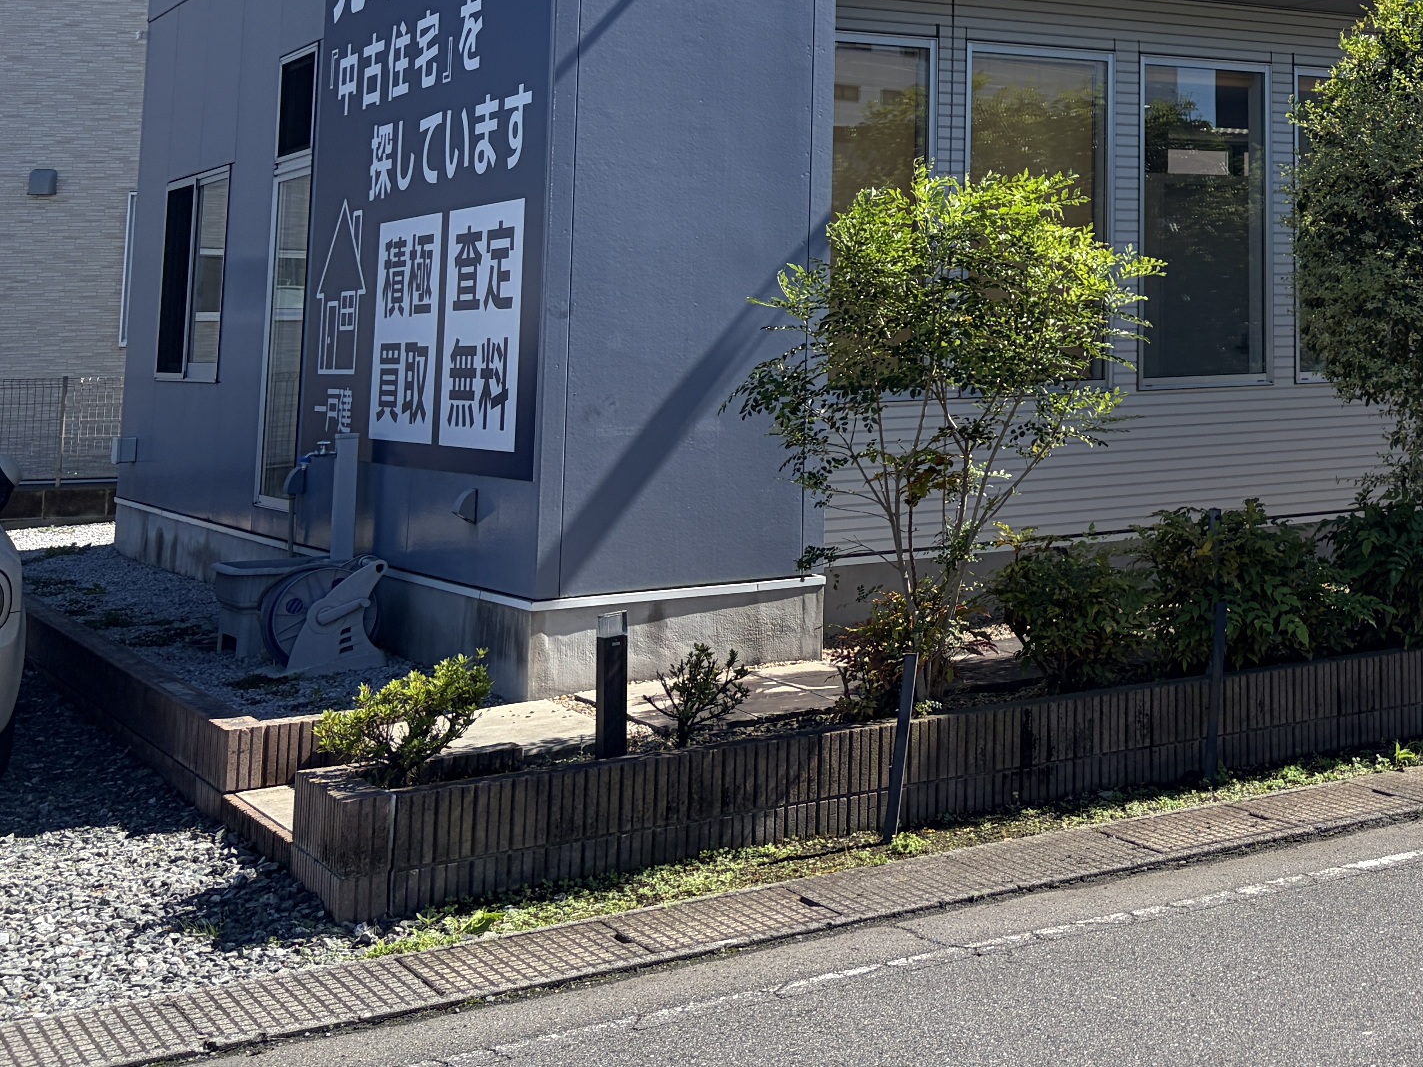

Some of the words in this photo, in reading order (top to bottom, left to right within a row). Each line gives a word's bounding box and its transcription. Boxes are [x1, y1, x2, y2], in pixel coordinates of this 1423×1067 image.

[368, 83, 533, 201] 探しています
[382, 233, 435, 319] 積極
[452, 220, 516, 313] 査定
[314, 386, 353, 433] 一戸建
[376, 342, 429, 425] 買取
[447, 337, 509, 432] 無料
